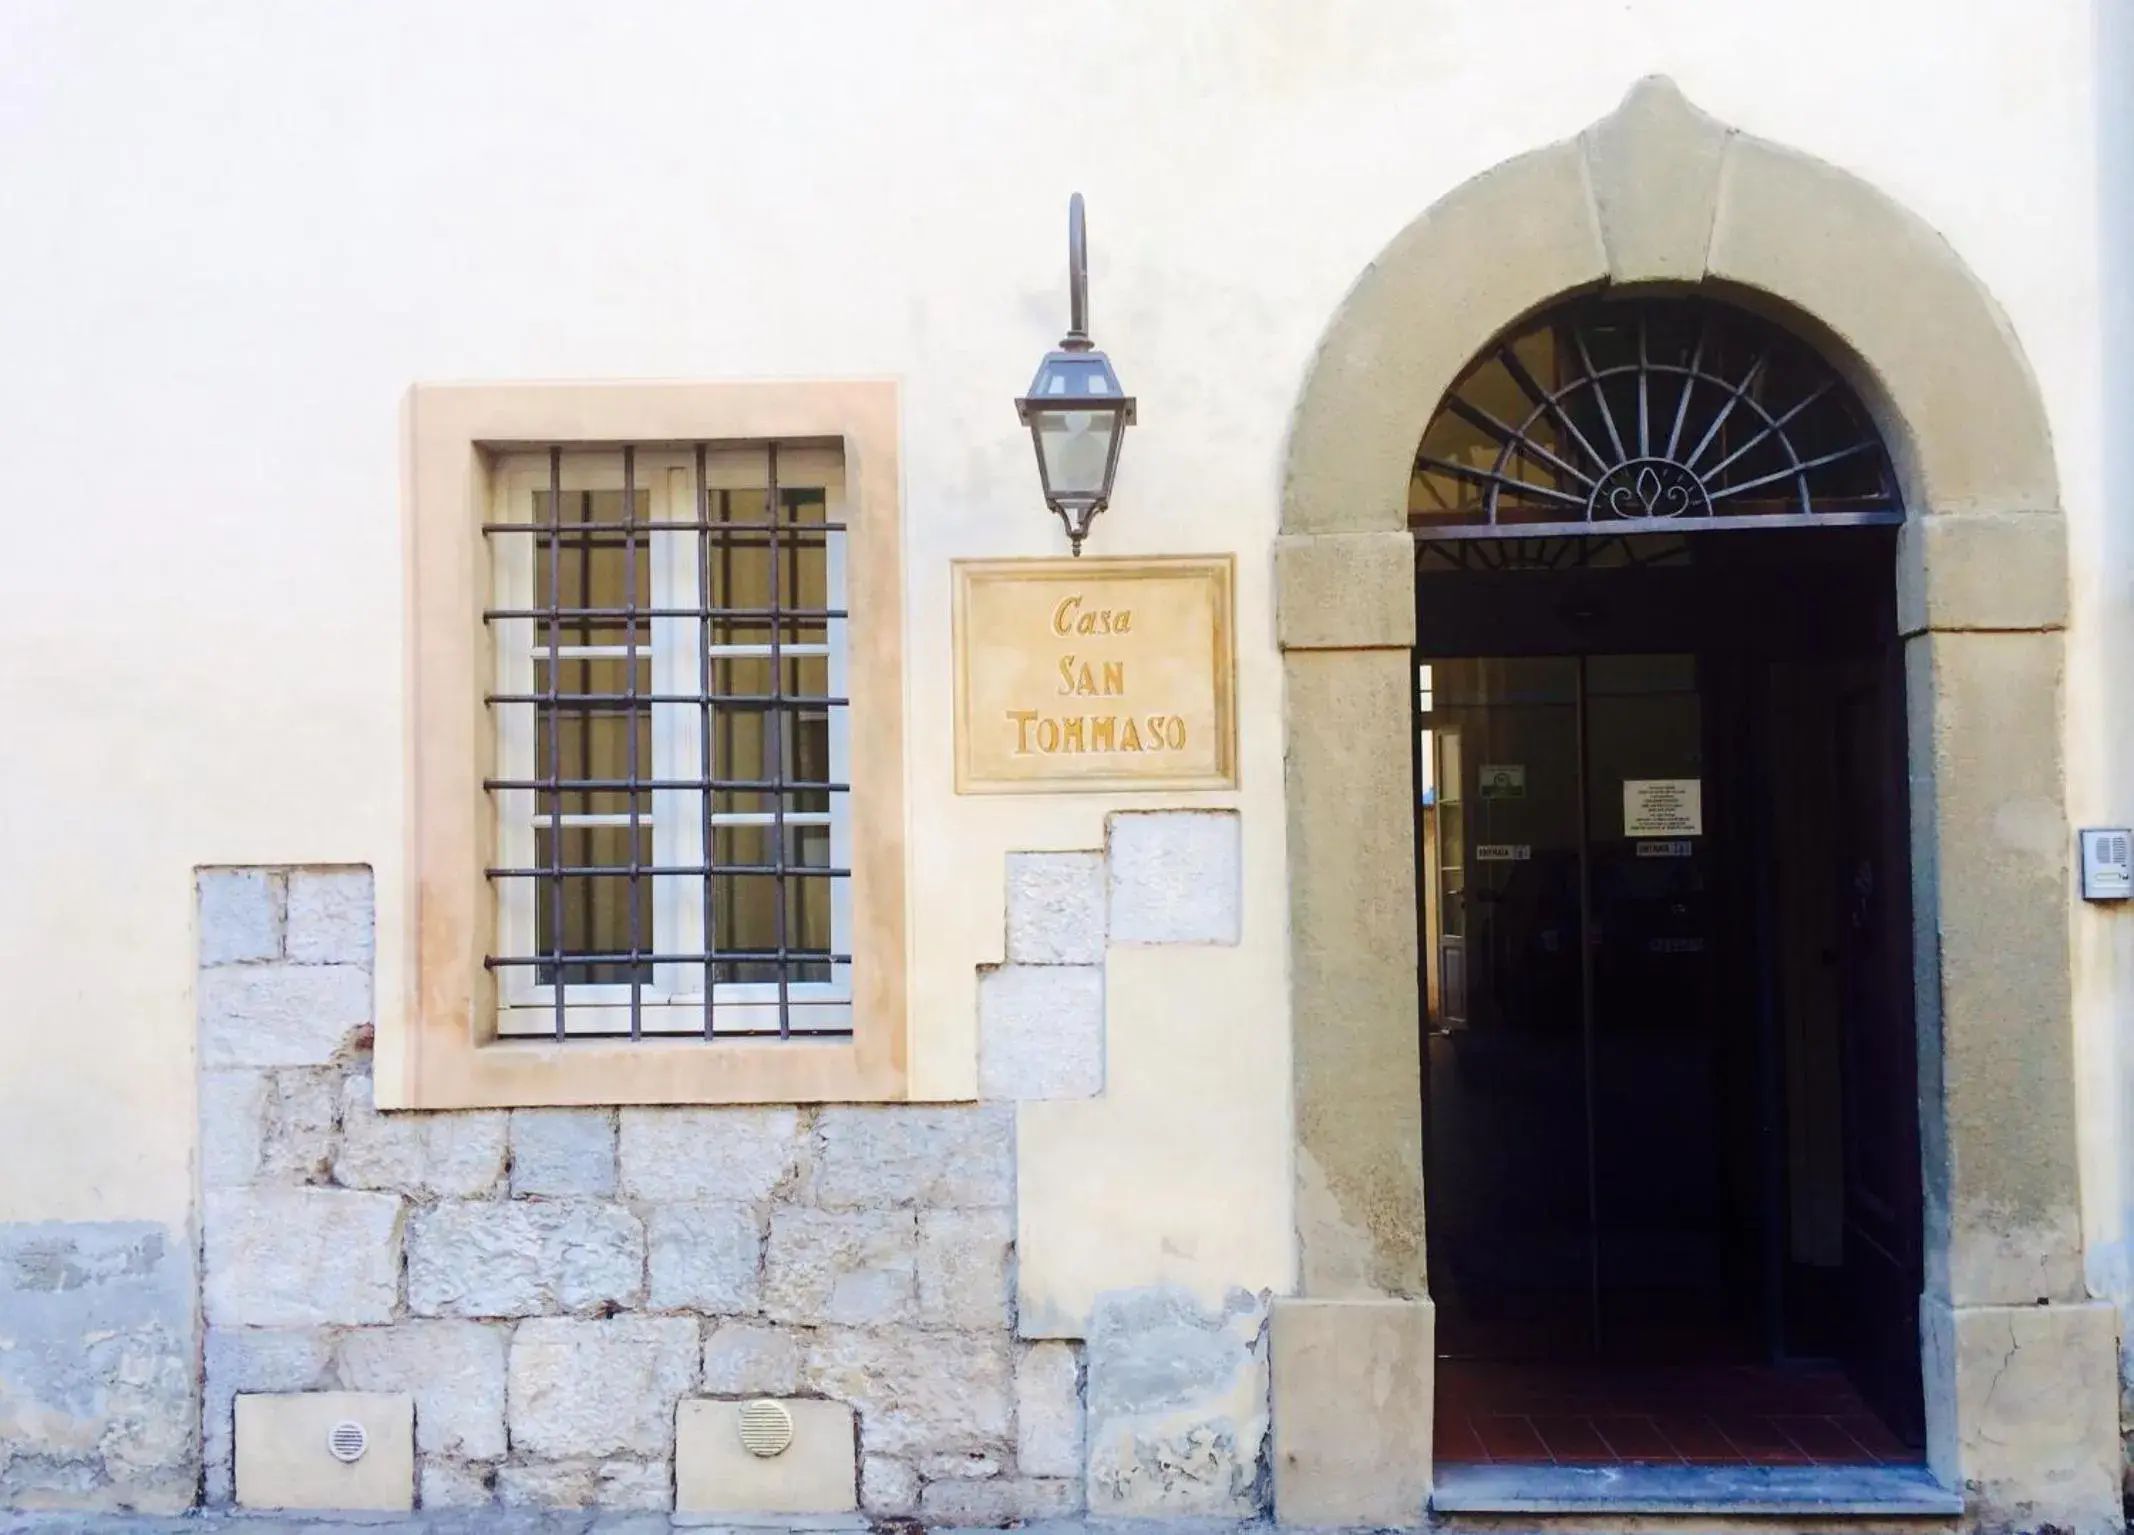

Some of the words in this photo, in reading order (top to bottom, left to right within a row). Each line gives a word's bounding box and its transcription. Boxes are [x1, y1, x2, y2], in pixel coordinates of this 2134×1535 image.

[1053, 595, 1133, 637] Casa
[1057, 654, 1125, 697] SAN
[1006, 708, 1187, 755] TOMMASO
